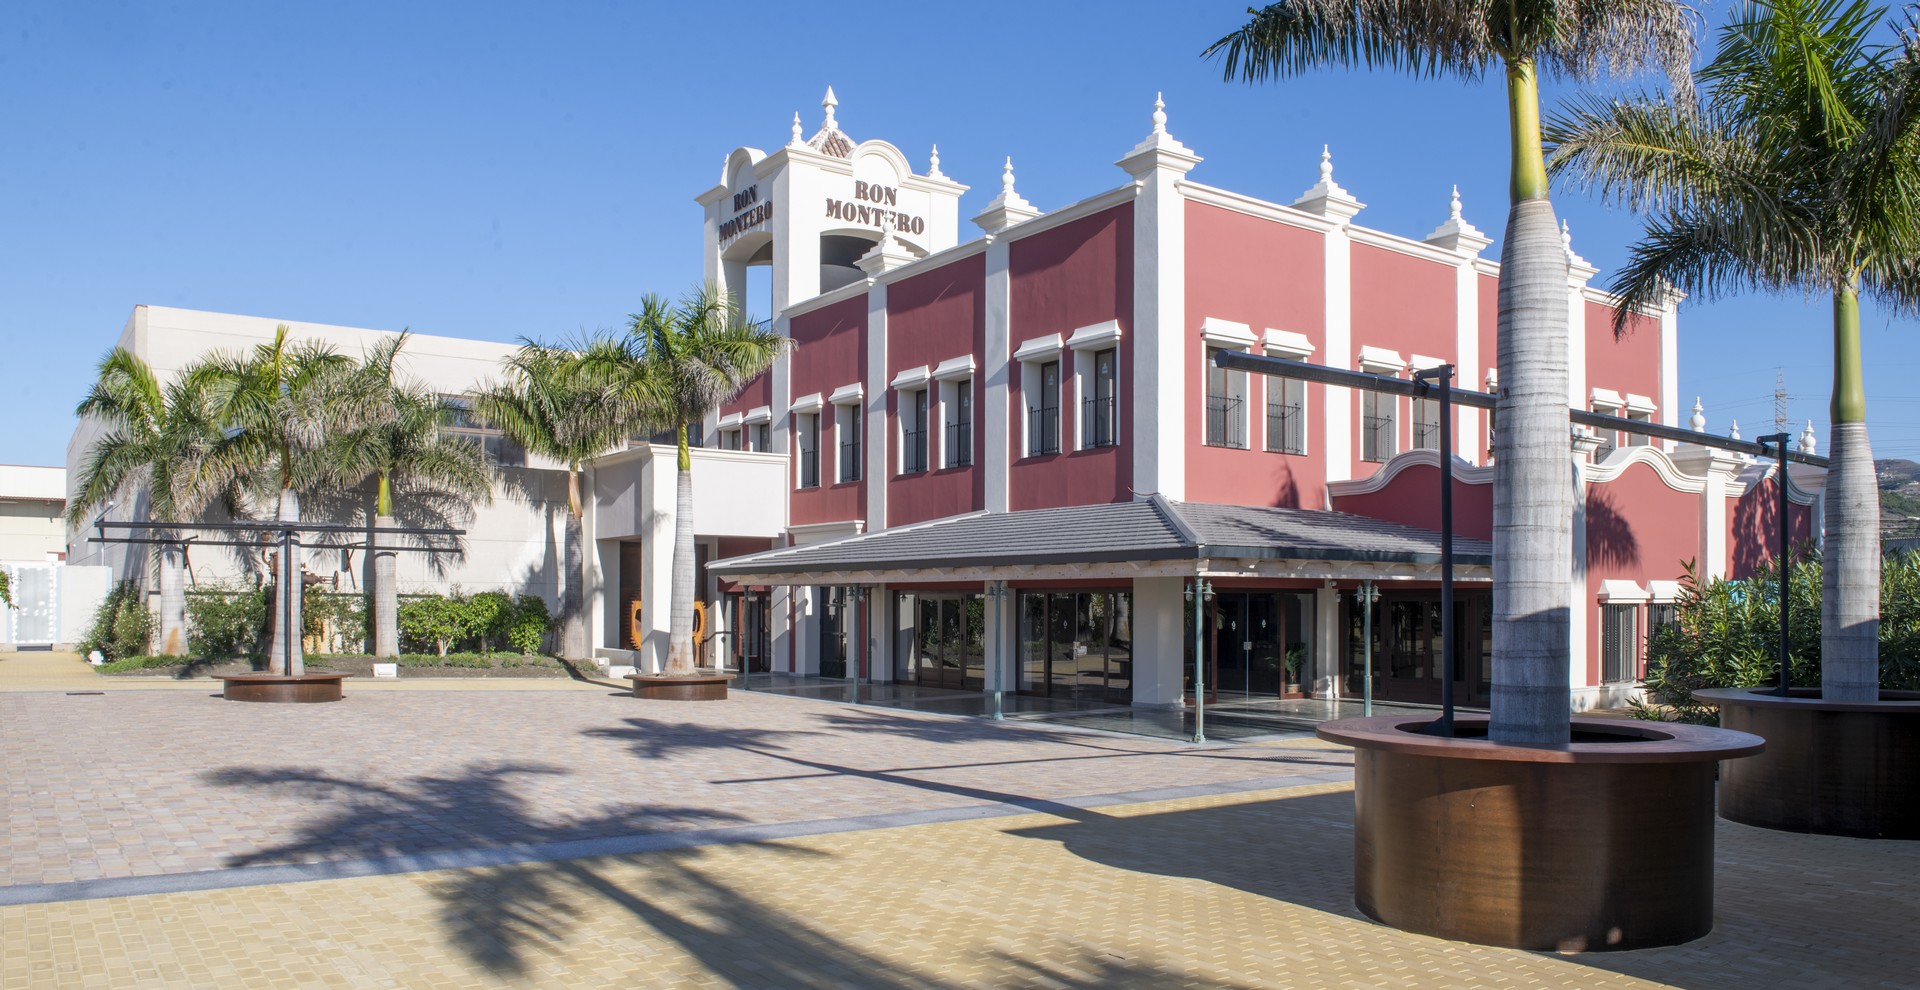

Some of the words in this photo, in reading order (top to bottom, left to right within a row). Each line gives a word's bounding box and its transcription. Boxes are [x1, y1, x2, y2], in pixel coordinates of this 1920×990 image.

[734, 184, 757, 212] RON
[855, 180, 897, 206] RON
[719, 201, 772, 241] MONTERO
